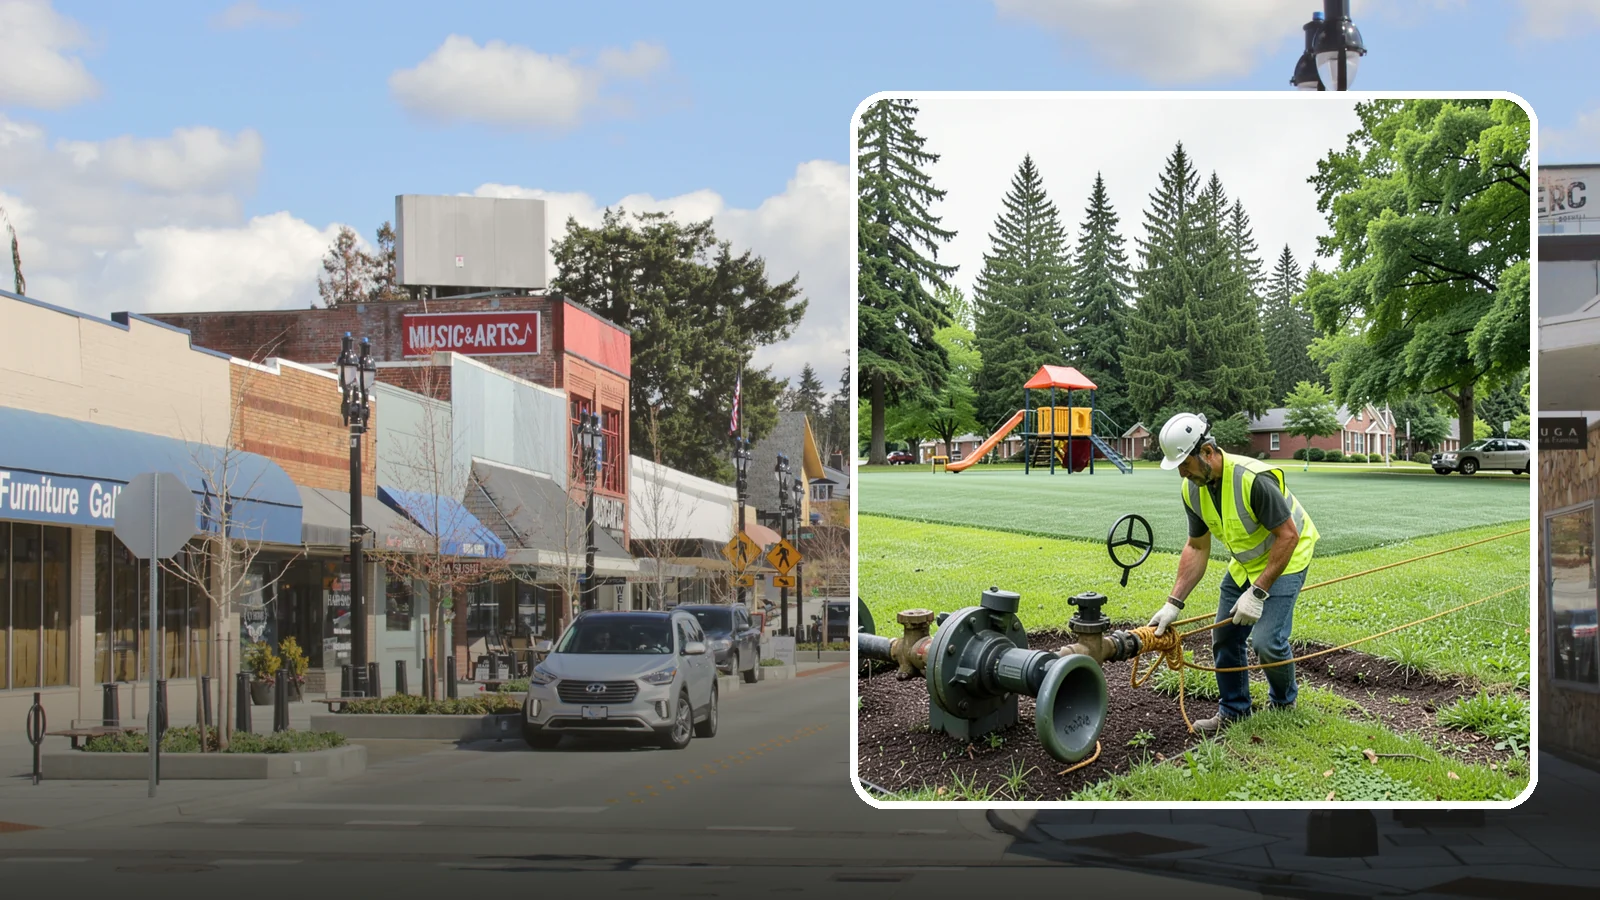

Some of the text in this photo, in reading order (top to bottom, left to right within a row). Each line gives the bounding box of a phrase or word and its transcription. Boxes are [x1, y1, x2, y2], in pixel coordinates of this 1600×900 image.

[409, 322, 519, 349] MUSIC&ARTS
[0, 471, 122, 519] Furniture Gal
